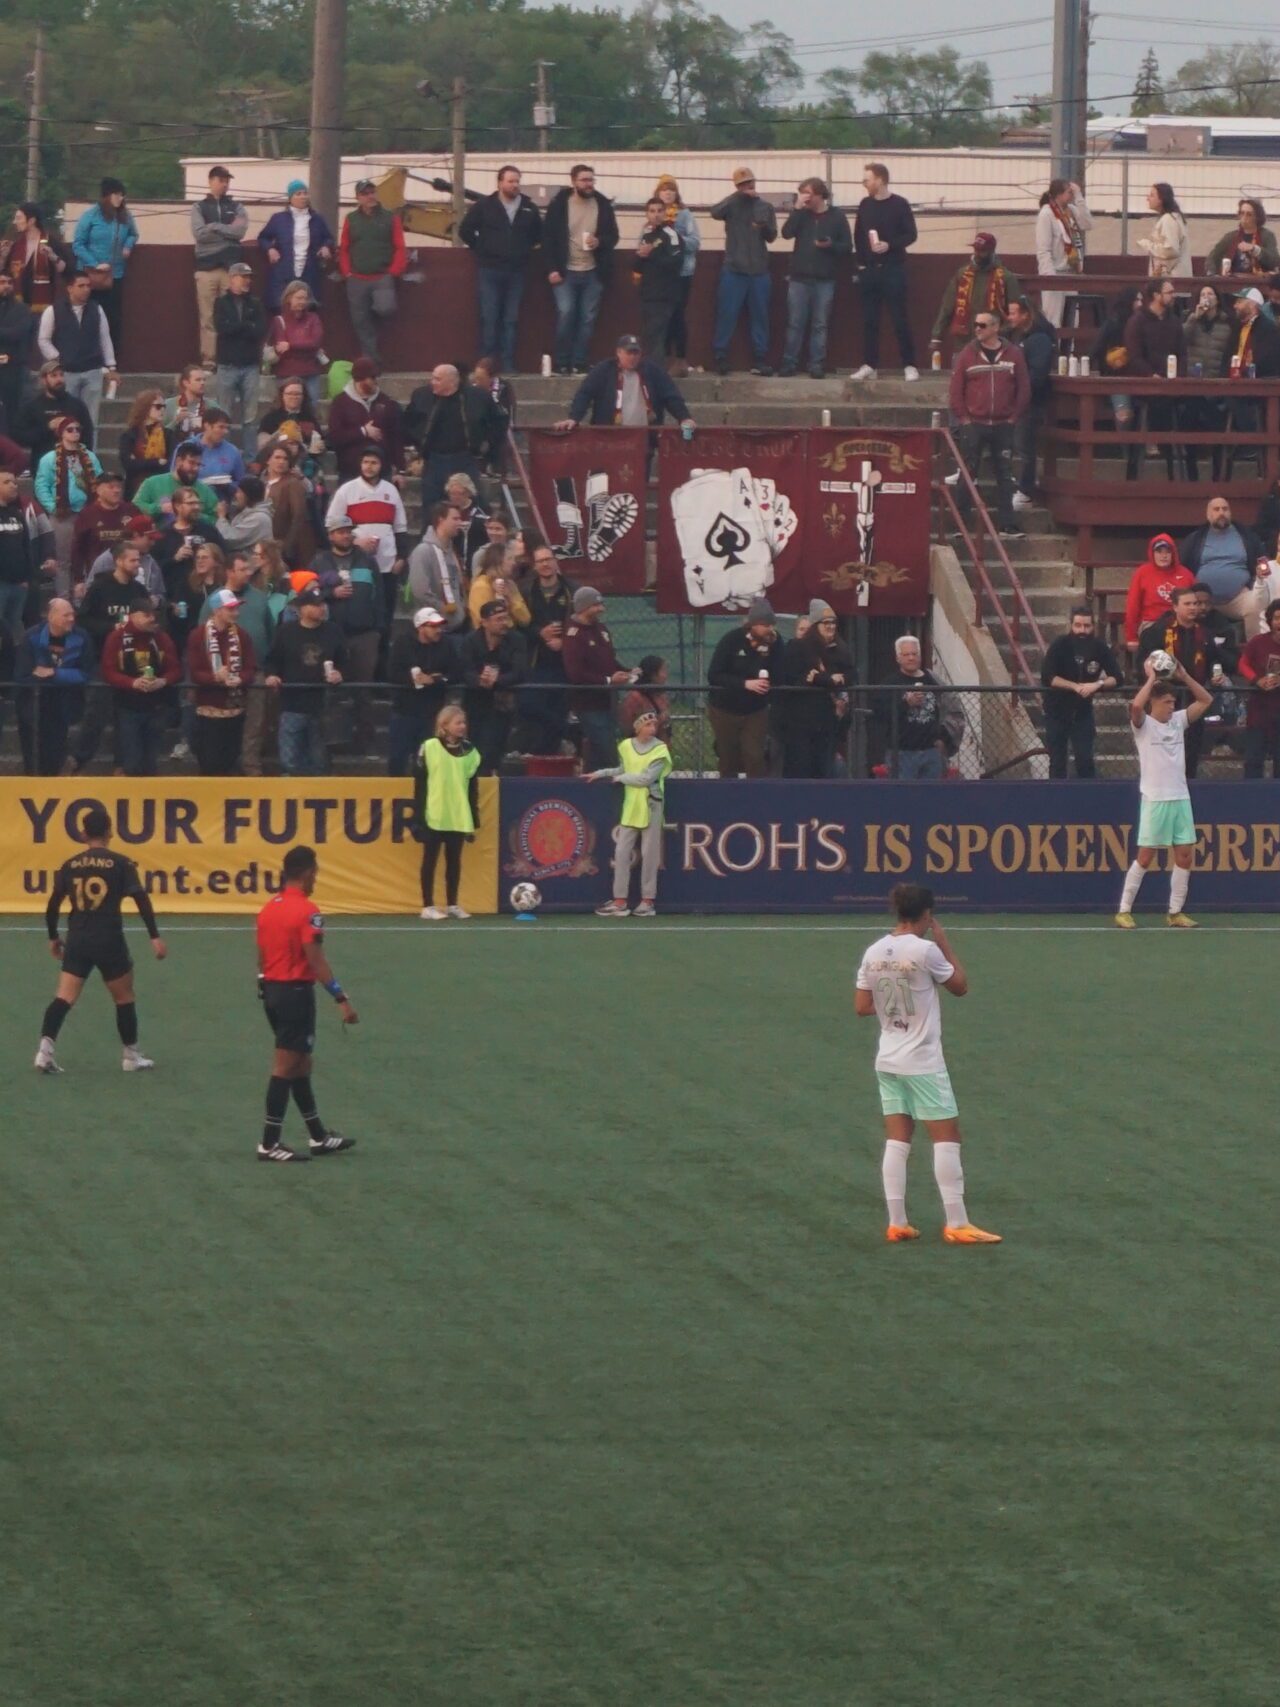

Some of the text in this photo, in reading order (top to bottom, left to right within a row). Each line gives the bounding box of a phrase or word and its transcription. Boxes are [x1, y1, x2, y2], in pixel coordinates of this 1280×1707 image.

[19, 798, 203, 844] YOUR
[224, 798, 424, 844] FUTUR
[864, 823, 912, 873] IS
[926, 823, 1132, 872] SPOKEN
[23, 862, 286, 894] unt.edu
[73, 876, 108, 911] 19
